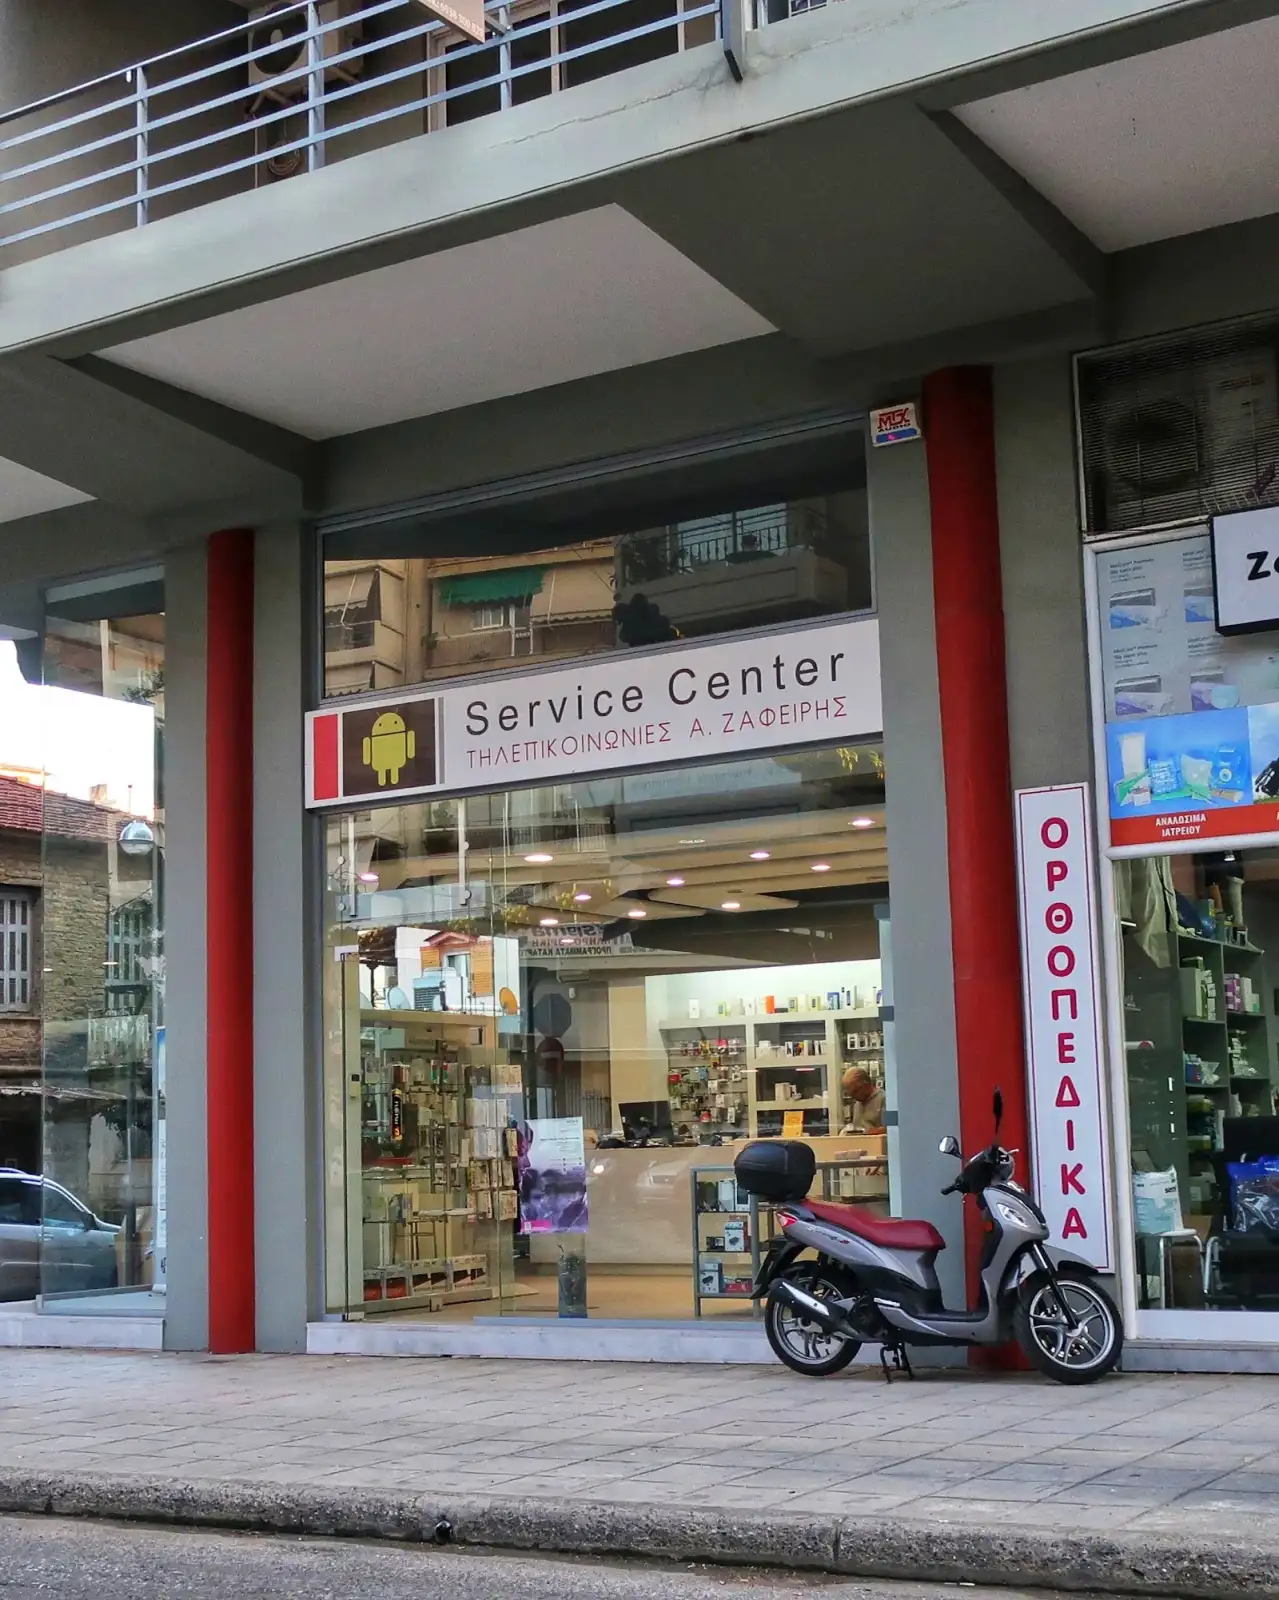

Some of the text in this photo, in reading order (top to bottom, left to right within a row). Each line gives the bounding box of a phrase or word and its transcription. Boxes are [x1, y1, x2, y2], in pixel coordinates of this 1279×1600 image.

[878, 408, 911, 429] MTX
[878, 423, 911, 432] AUDIO
[465, 652, 844, 736] Service Center
[466, 721, 671, 769] ΤΗΛΕΠΙΚΟΙΝΩΝΙΕΣ
[722, 696, 848, 734] ΖΑΦΕΙΡΗΣ
[1155, 813, 1207, 827] ΑΝΑΛΩΣΙΜΑ
[1161, 825, 1201, 838] ΙΑΤΡΕΙΟΥ
[1040, 817, 1088, 1240] ΟΡΘΟΠΕΔΙΚΑ
